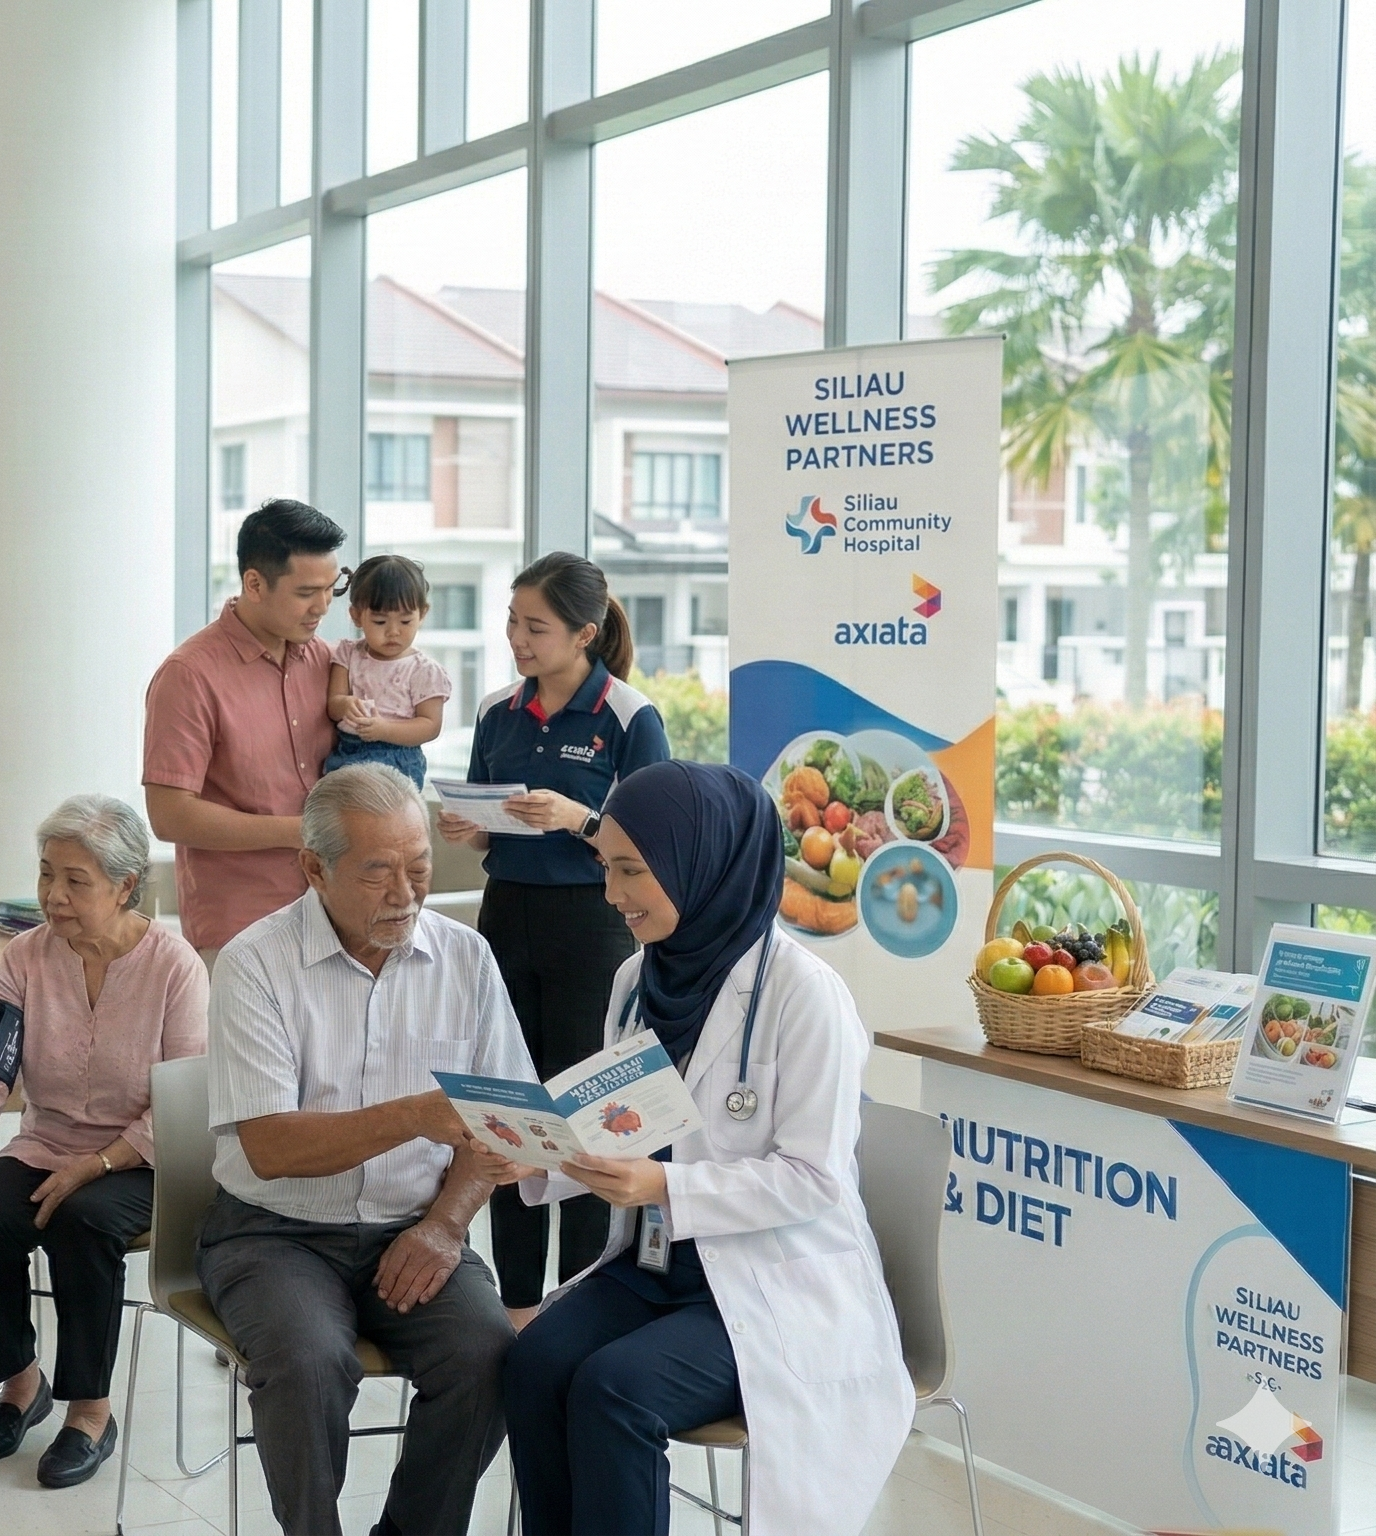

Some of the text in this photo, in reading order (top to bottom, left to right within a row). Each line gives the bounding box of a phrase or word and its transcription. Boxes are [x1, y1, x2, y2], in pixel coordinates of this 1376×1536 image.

[814, 371, 905, 401] SILIAU
[785, 404, 937, 437] WELLNESS
[786, 440, 934, 471] PARTNERS
[843, 493, 899, 512] Siliau
[843, 513, 952, 534] Community
[843, 534, 920, 555] Hospital
[834, 616, 927, 646] axiata
[976, 1181, 1072, 1248] DIET
[1236, 1286, 1301, 1322] SILIAU
[1215, 1304, 1325, 1355] WELLNESS
[1216, 1330, 1323, 1381] PARTNERS
